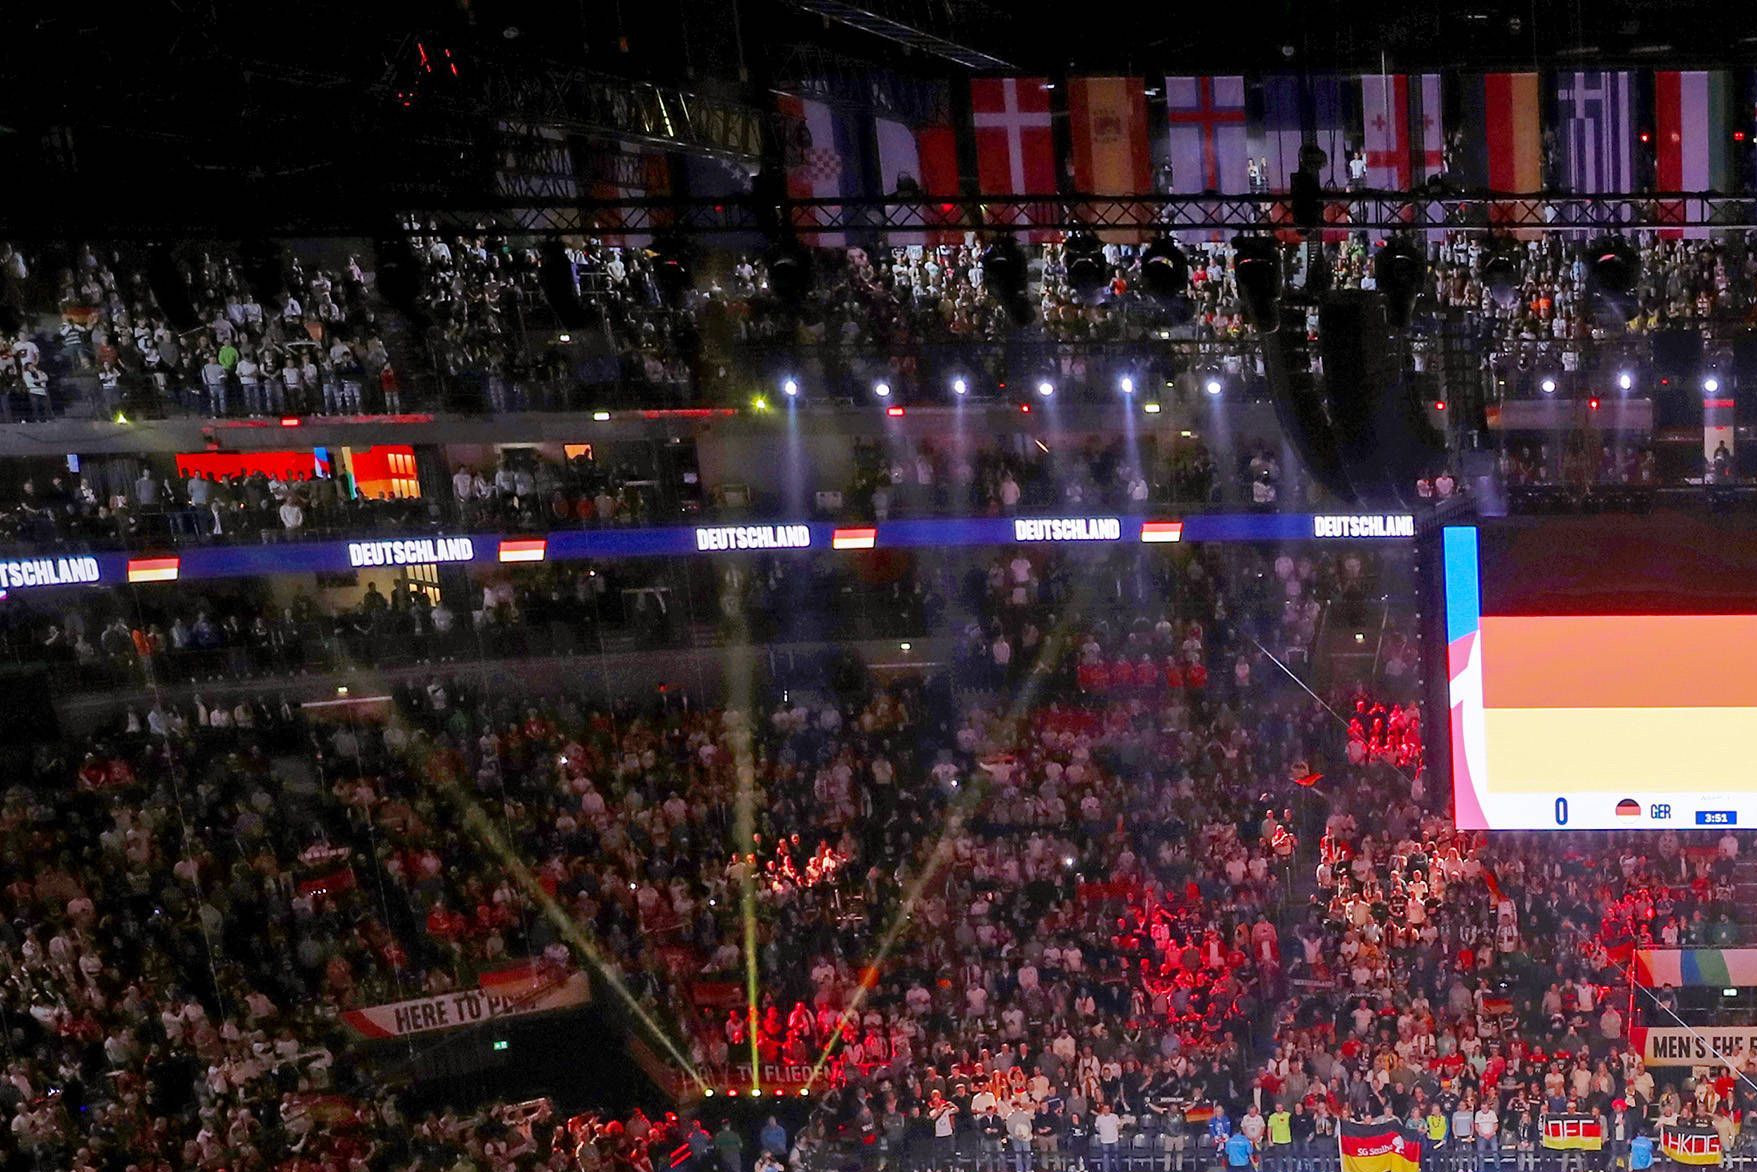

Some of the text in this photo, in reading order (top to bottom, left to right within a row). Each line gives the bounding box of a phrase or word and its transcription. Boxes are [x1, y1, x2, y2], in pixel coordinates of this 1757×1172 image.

[696, 525, 811, 550] DEUTSCHLAND
[1015, 518, 1121, 541] DEUTSCHLAND
[1314, 515, 1415, 538] DEUTSCHLAND
[349, 538, 474, 567] DEUTSCHLAND
[1555, 797, 1671, 826] 0 GER
[1705, 813, 1728, 823] 3:51
[394, 1001, 448, 1032] HERE
[453, 996, 481, 1022] TO
[1653, 1035, 1706, 1059] MEN'S
[1712, 1036, 1743, 1059] EHF
